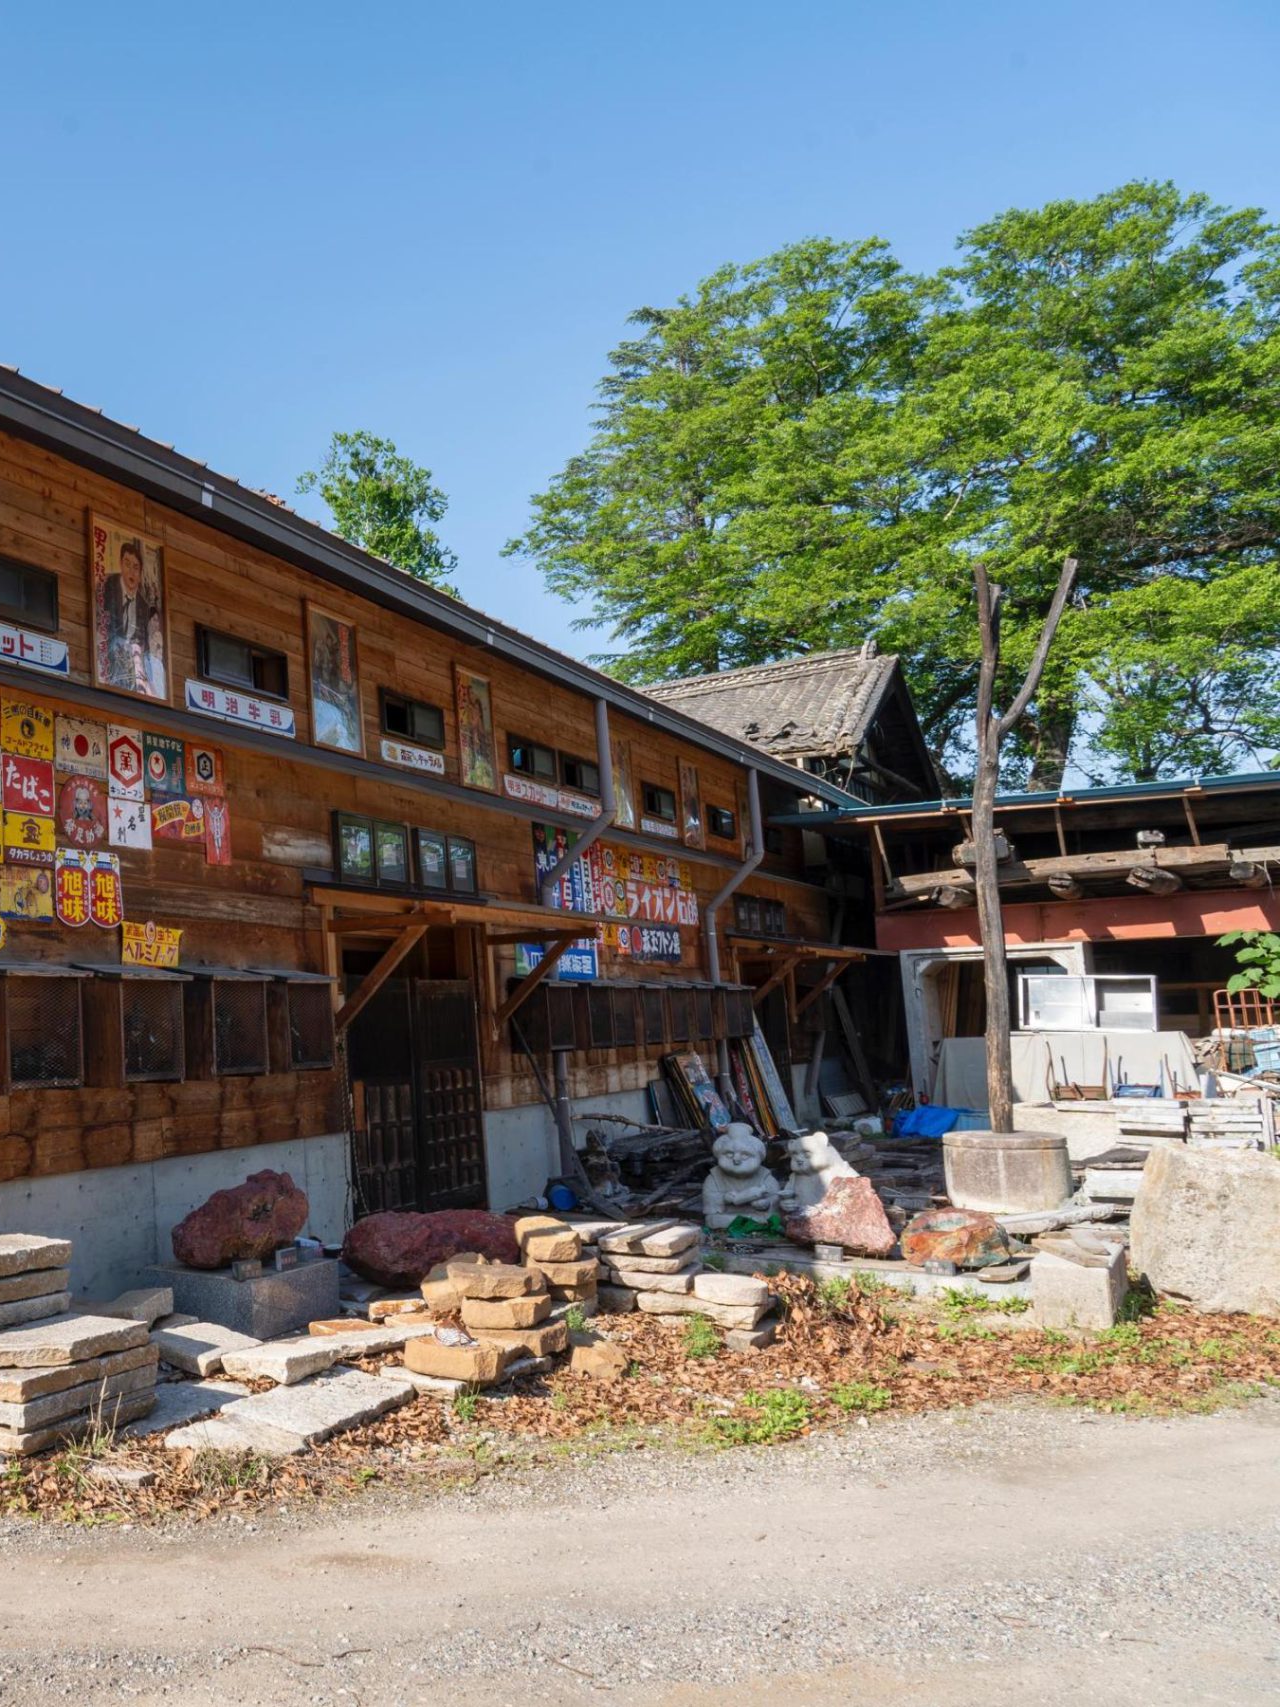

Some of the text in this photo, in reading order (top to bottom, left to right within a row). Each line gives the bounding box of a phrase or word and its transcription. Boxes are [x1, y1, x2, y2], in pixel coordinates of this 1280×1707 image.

[201, 689, 283, 728] 明治牛乳
[5, 760, 51, 812] たばこ
[110, 786, 143, 798] キッコーマン
[62, 870, 85, 923] 旭味
[95, 872, 119, 924] 旭味
